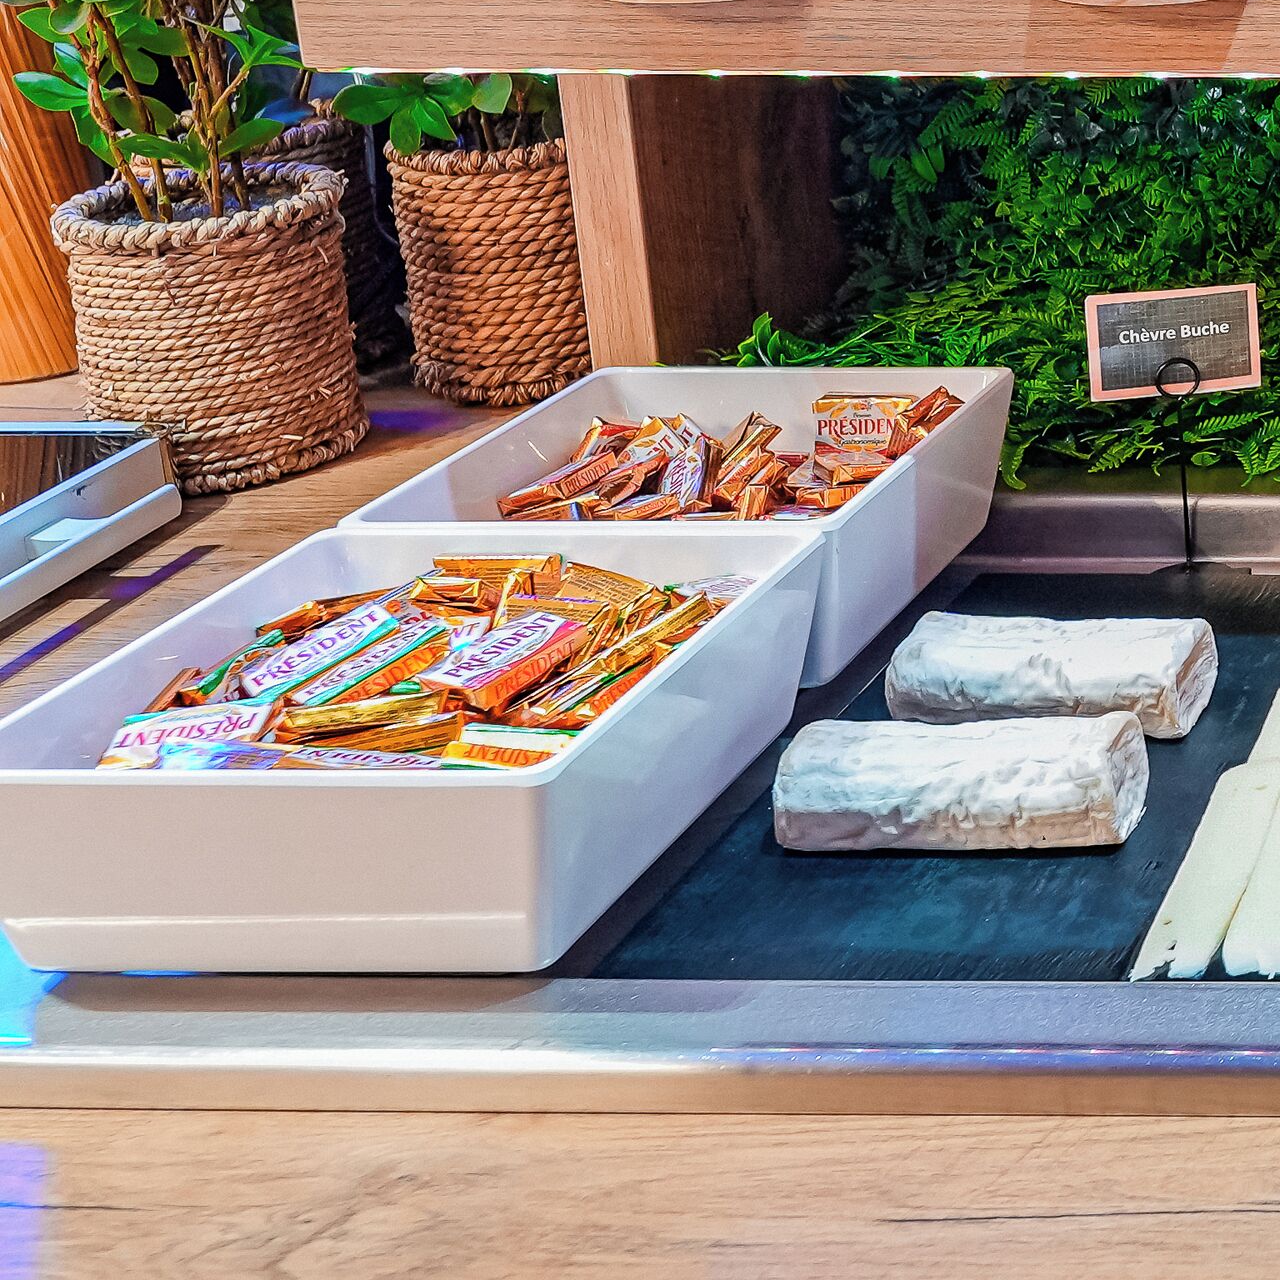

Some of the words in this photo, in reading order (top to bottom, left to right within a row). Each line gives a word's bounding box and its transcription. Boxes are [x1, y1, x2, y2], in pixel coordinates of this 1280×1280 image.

[1118, 327, 1177, 345] Chèvre
[1180, 320, 1231, 338] Buche
[817, 417, 898, 436] PRÉSIDEN
